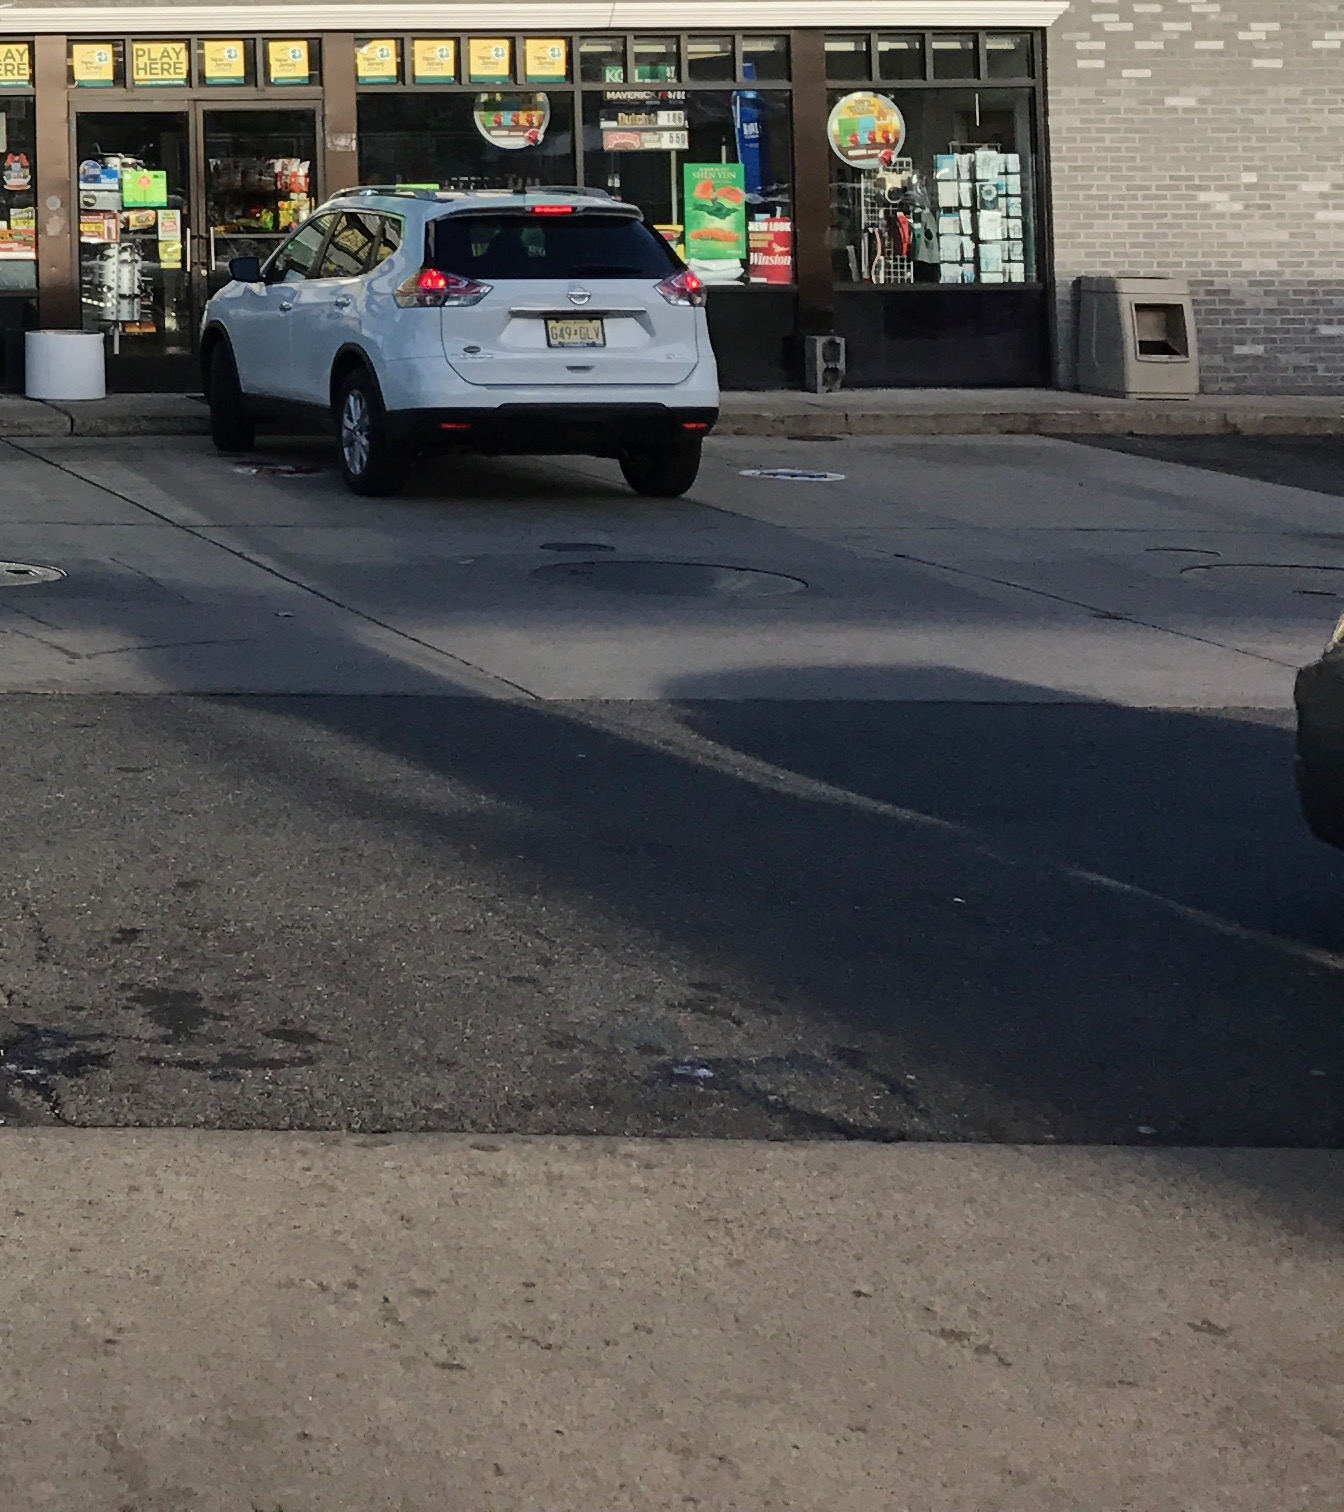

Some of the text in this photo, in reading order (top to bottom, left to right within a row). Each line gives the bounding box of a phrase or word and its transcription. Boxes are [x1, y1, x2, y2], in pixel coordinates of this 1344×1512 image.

[135, 47, 184, 61] PLAY
[135, 61, 184, 76] HERE
[605, 68, 644, 83] KOL
[617, 112, 647, 125] Dutch
[691, 171, 737, 179] SHEN YUN
[749, 221, 792, 232] NEW LOOK
[749, 252, 792, 266] Winston
